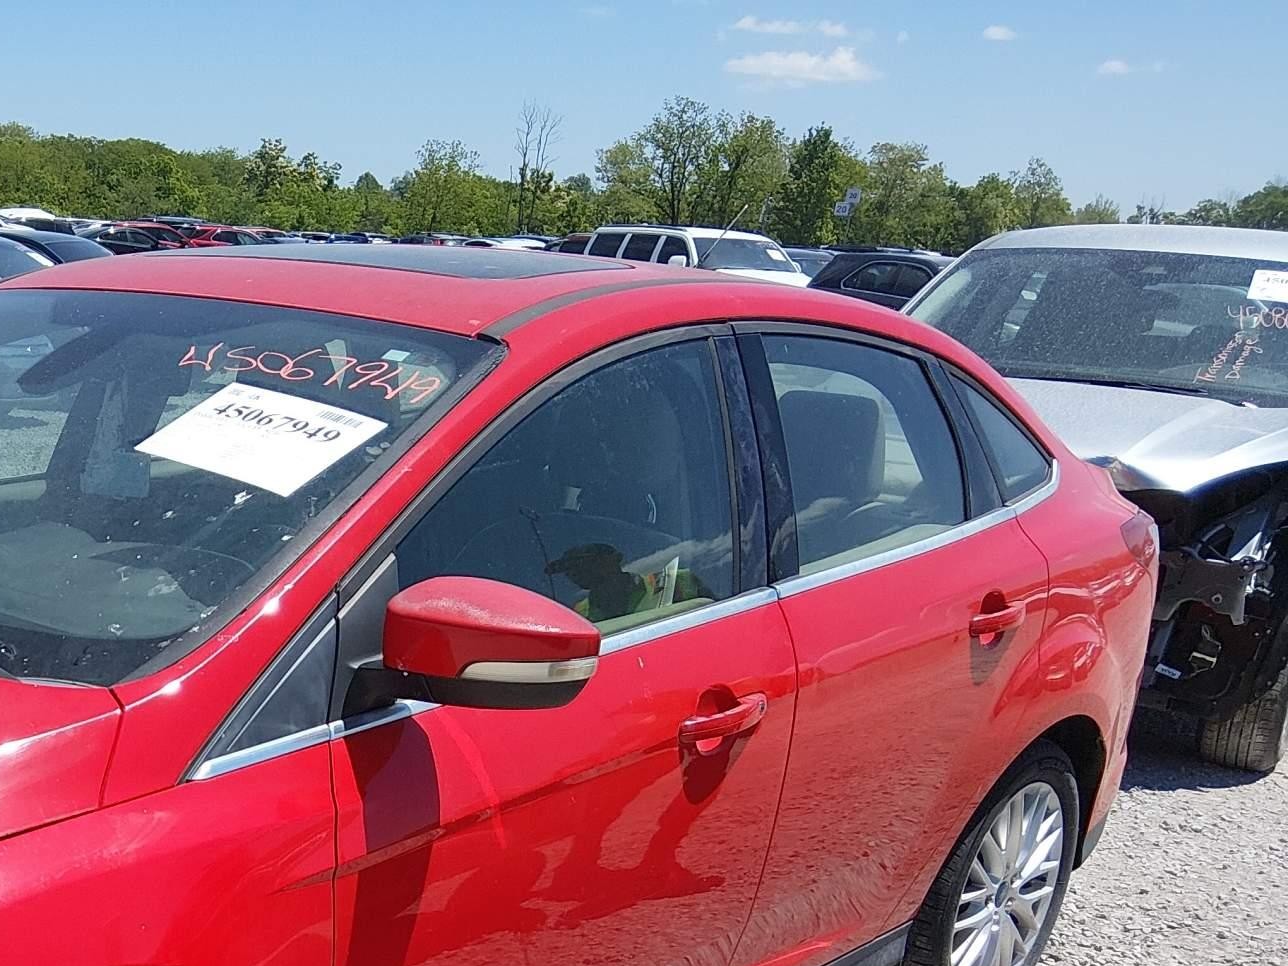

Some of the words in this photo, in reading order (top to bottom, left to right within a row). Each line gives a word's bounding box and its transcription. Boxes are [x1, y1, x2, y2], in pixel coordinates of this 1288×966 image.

[836, 205, 848, 214] 20
[178, 342, 441, 404] 45067949
[213, 403, 341, 442] 45067949
